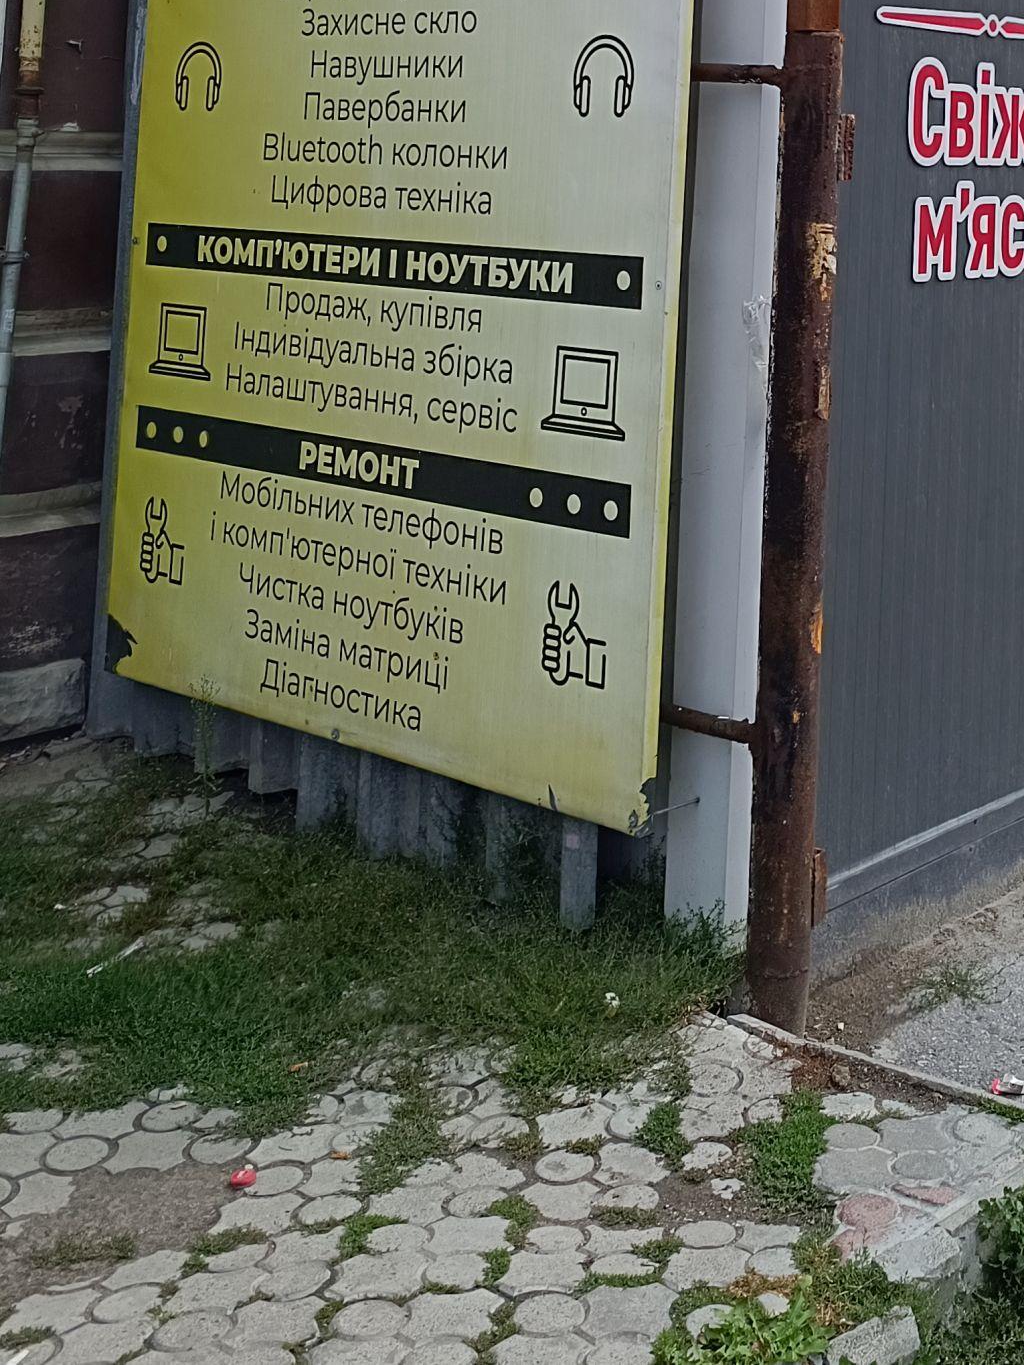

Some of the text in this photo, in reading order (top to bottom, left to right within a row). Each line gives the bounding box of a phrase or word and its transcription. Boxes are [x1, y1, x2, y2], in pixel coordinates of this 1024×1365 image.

[300, 5, 478, 37] Захисне скло
[309, 49, 465, 85] Навушники
[303, 90, 468, 131] Павербанки
[262, 132, 509, 170] Bluetooth колонки
[270, 174, 494, 215] Цифрова техніка
[387, 249, 398, 279] І
[405, 251, 574, 296] НОУТБУКИ
[265, 281, 483, 333] Продаж, купівля
[232, 321, 515, 385] Індивідуальна збірка
[224, 362, 519, 434] Налаштування, сервіс
[298, 439, 420, 491] РЕМОНТ
[219, 471, 506, 557] Мобільних телефонів
[209, 511, 508, 606] і комп'ютерної техніки
[238, 562, 466, 647] Чистка ноутбуків
[244, 608, 450, 692] Заміна матриці
[259, 656, 424, 733] Діагностика
